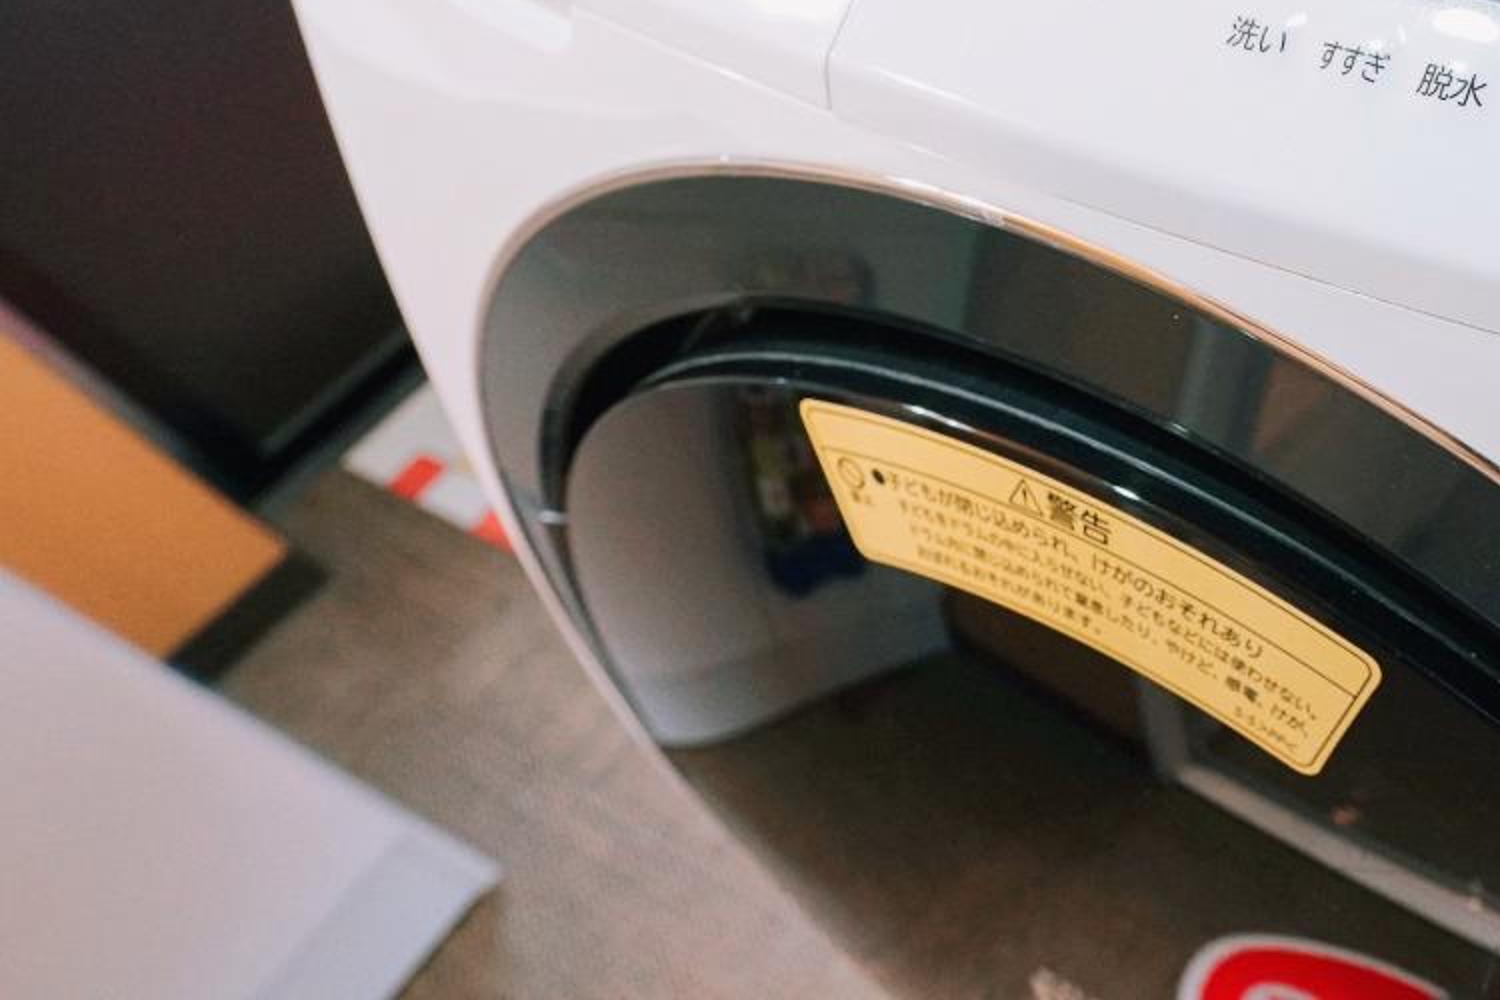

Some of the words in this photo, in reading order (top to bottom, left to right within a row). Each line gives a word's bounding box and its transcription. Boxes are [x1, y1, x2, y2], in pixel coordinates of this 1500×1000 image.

[1226, 15, 1287, 56] 洗い
[1319, 41, 1391, 84] すすぎ
[1416, 63, 1488, 110] 脱水
[1047, 490, 1111, 546] 警告
